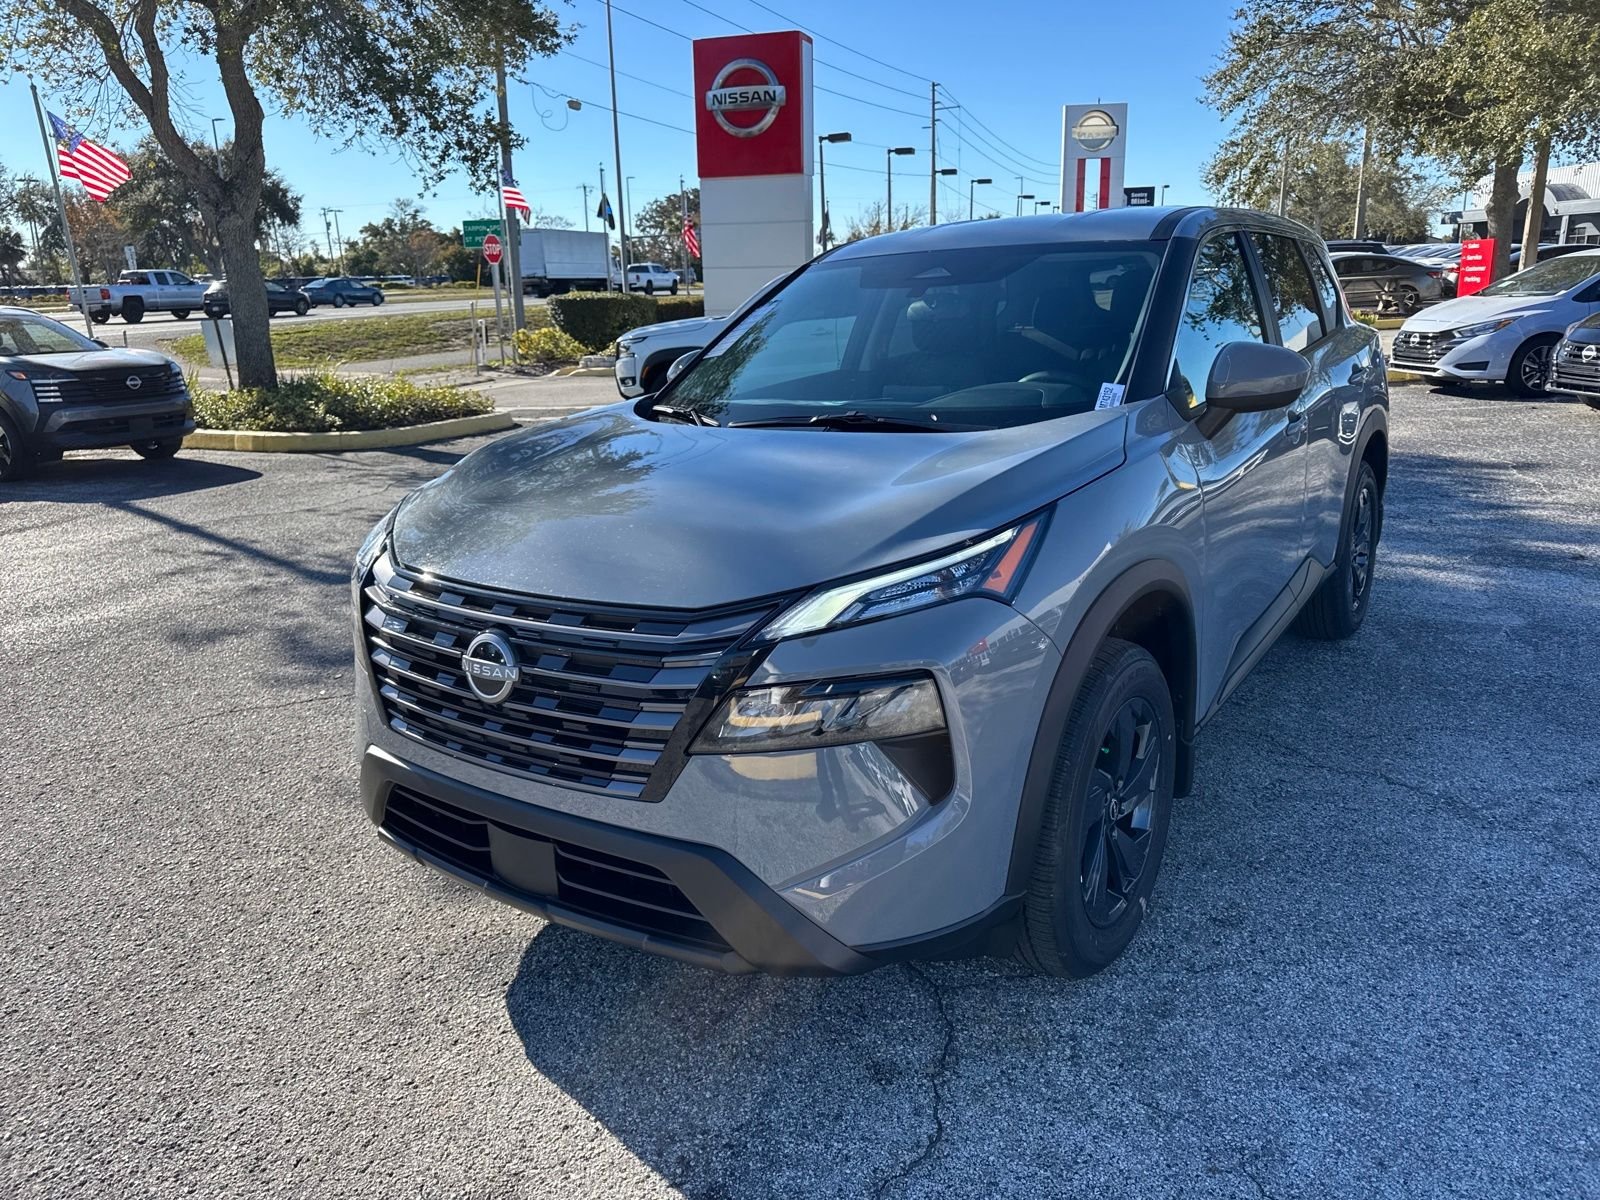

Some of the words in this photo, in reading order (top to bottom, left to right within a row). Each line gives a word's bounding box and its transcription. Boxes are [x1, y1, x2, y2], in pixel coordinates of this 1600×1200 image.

[712, 90, 777, 106] NISSAN
[485, 243, 501, 255] STOP
[1463, 276, 1481, 284] Parking
[462, 659, 516, 679] NISSAN
